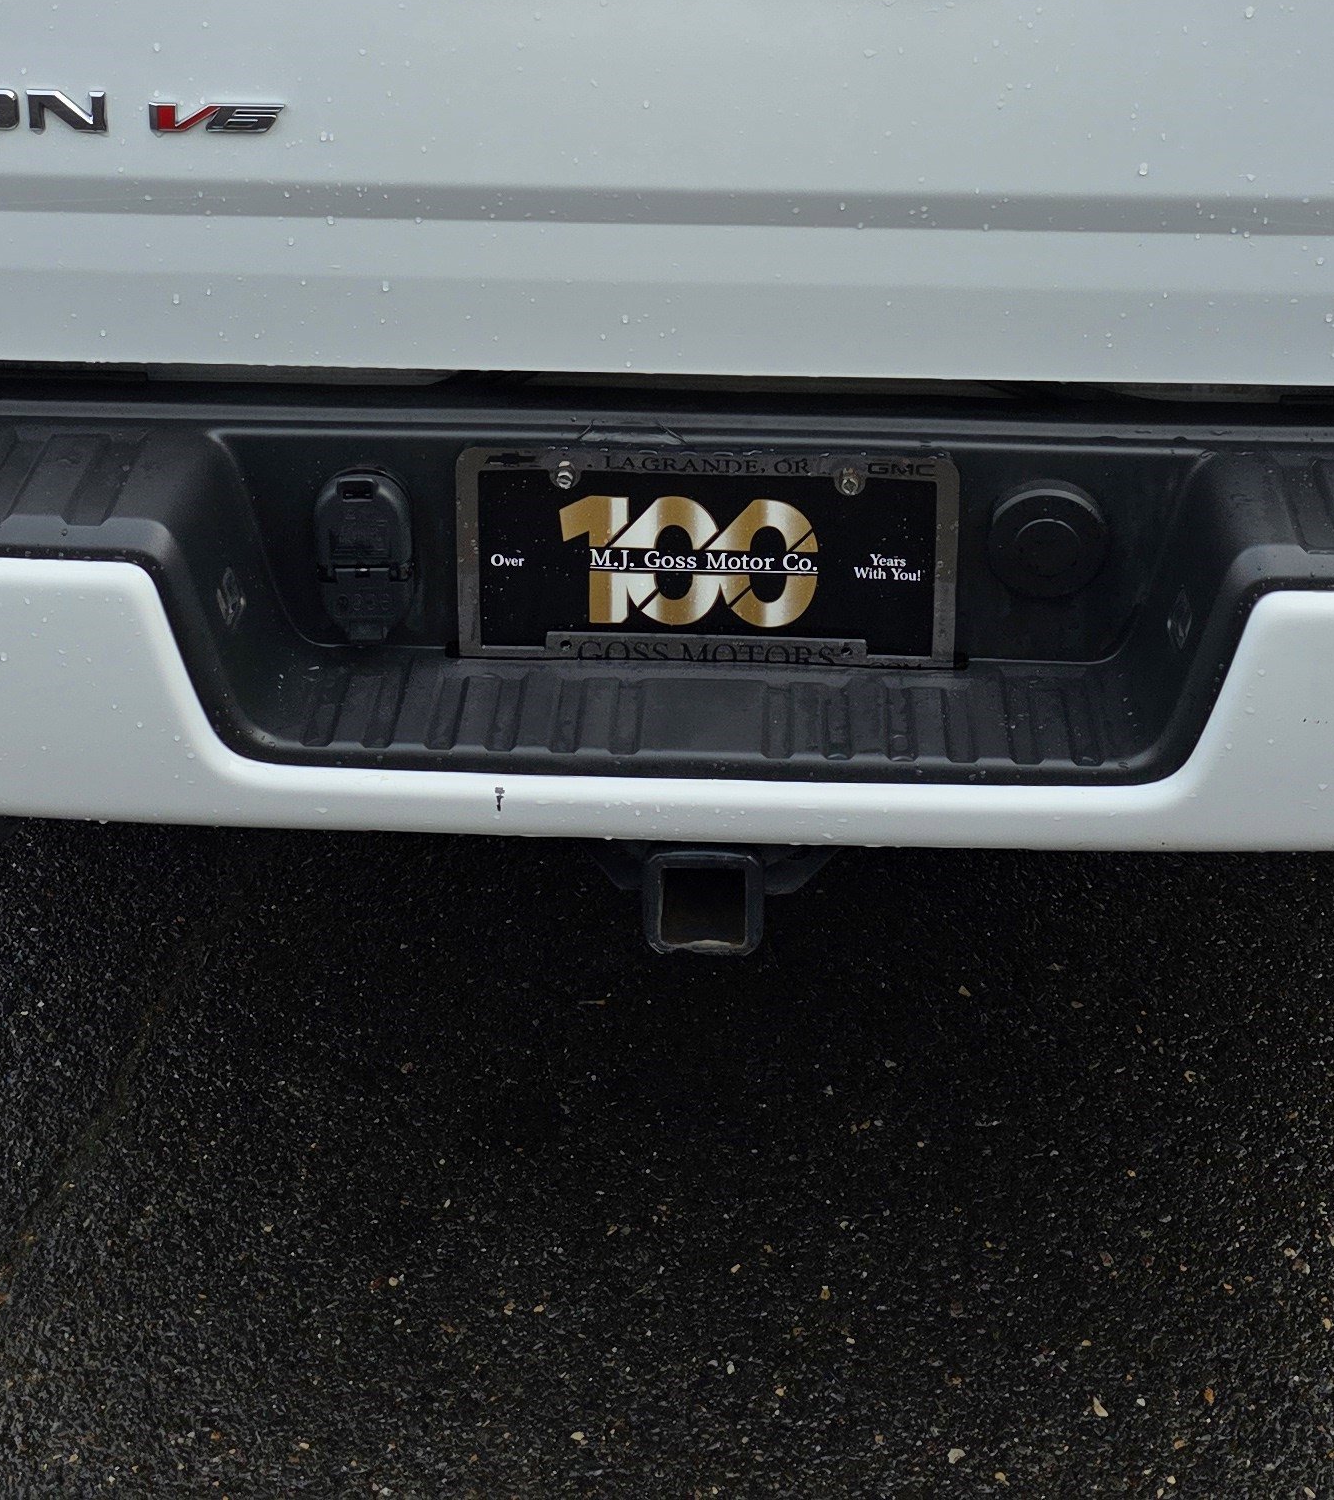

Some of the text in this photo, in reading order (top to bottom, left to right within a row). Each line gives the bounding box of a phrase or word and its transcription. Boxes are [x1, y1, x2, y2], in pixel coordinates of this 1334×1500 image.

[148, 100, 286, 135] V6
[867, 462, 936, 477] GMC
[490, 553, 525, 568] Over
[559, 495, 819, 628] 100
[589, 548, 819, 573] M.J. Goss Motor Co.
[869, 554, 906, 567] Years
[853, 566, 922, 582] With You!
[577, 640, 668, 660] GOSS
